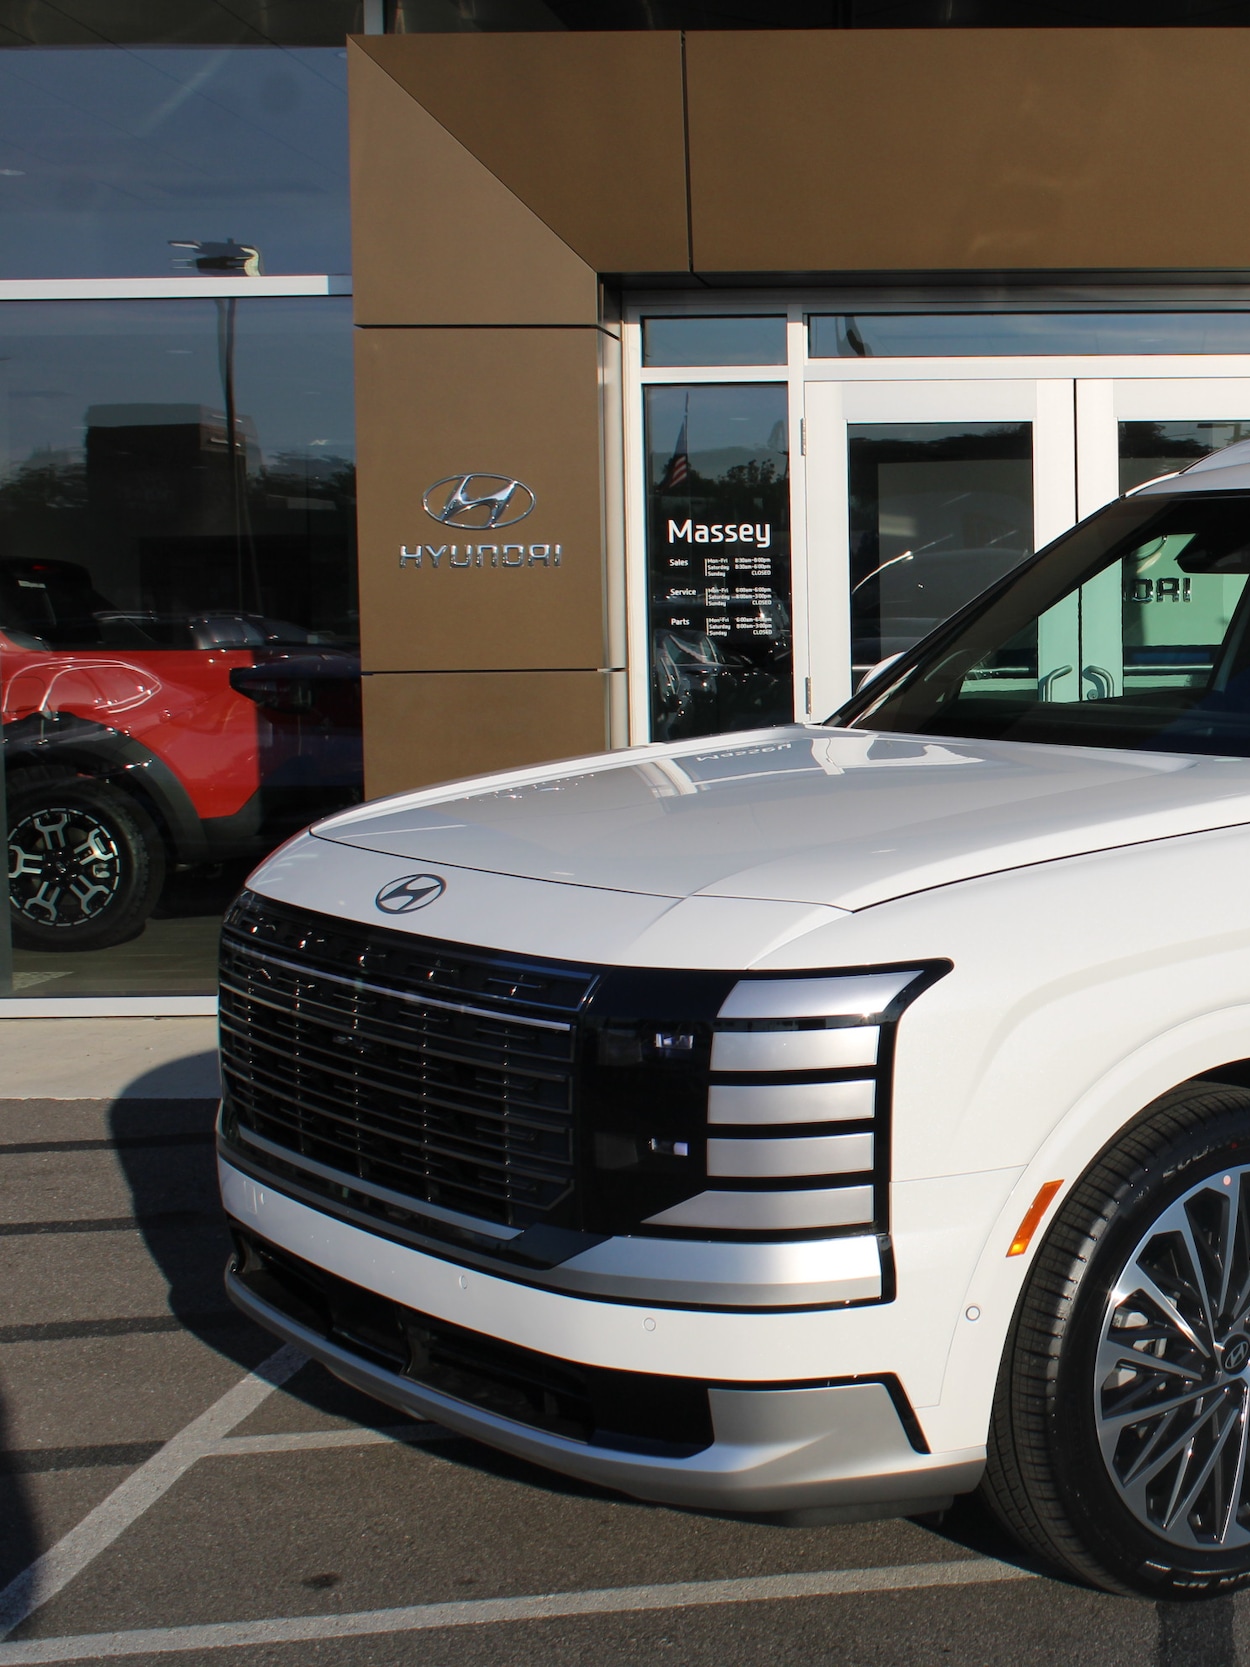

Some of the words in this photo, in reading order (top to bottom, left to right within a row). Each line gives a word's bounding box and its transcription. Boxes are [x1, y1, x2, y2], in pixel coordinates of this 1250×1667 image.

[668, 519, 771, 548] Massey
[400, 544, 561, 568] HYUNDAI
[670, 588, 697, 596] Service
[1123, 577, 1192, 603] DAI
[670, 618, 691, 626] Parts
